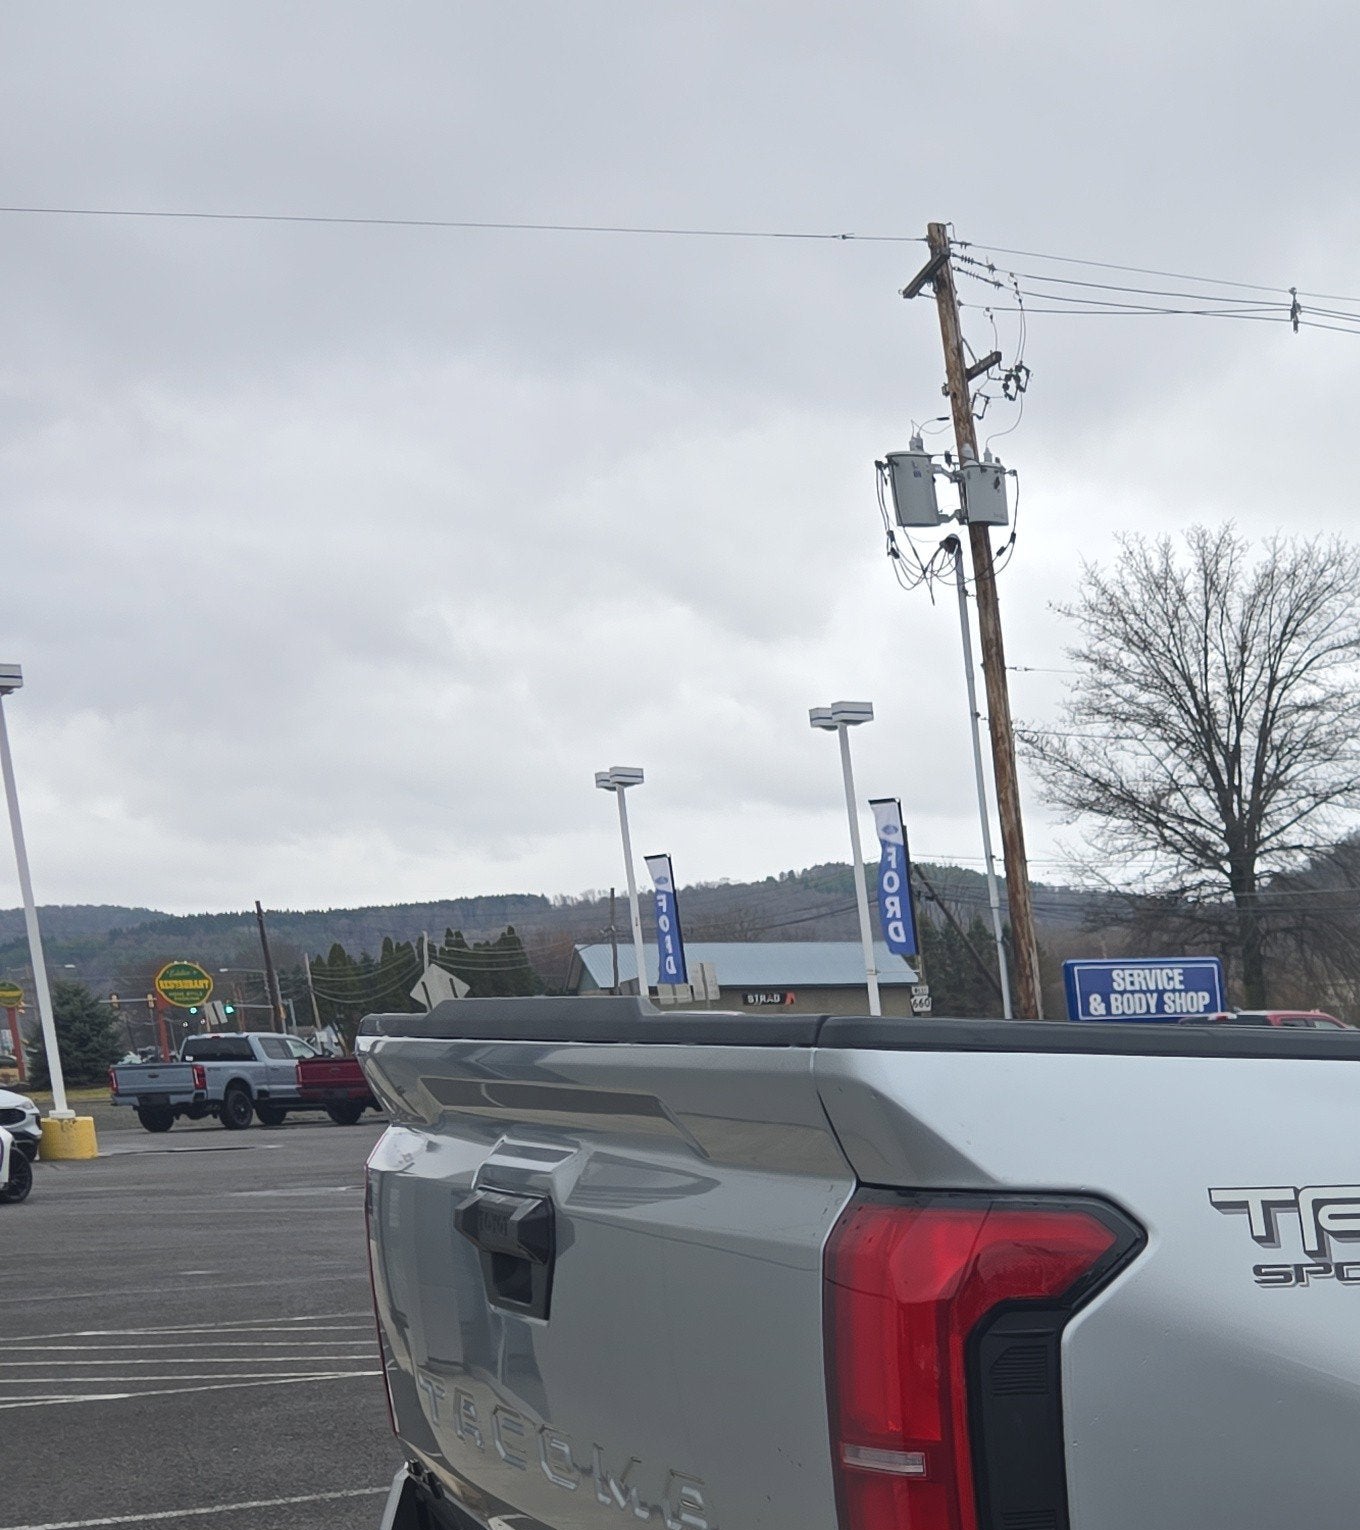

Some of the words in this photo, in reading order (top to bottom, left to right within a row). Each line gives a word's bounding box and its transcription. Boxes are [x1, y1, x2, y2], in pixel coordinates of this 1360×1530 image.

[1112, 969, 1185, 991] SERVICE
[1089, 993, 1106, 1016] &
[1110, 993, 1157, 1015] BODY
[1164, 992, 1210, 1013] SHOP
